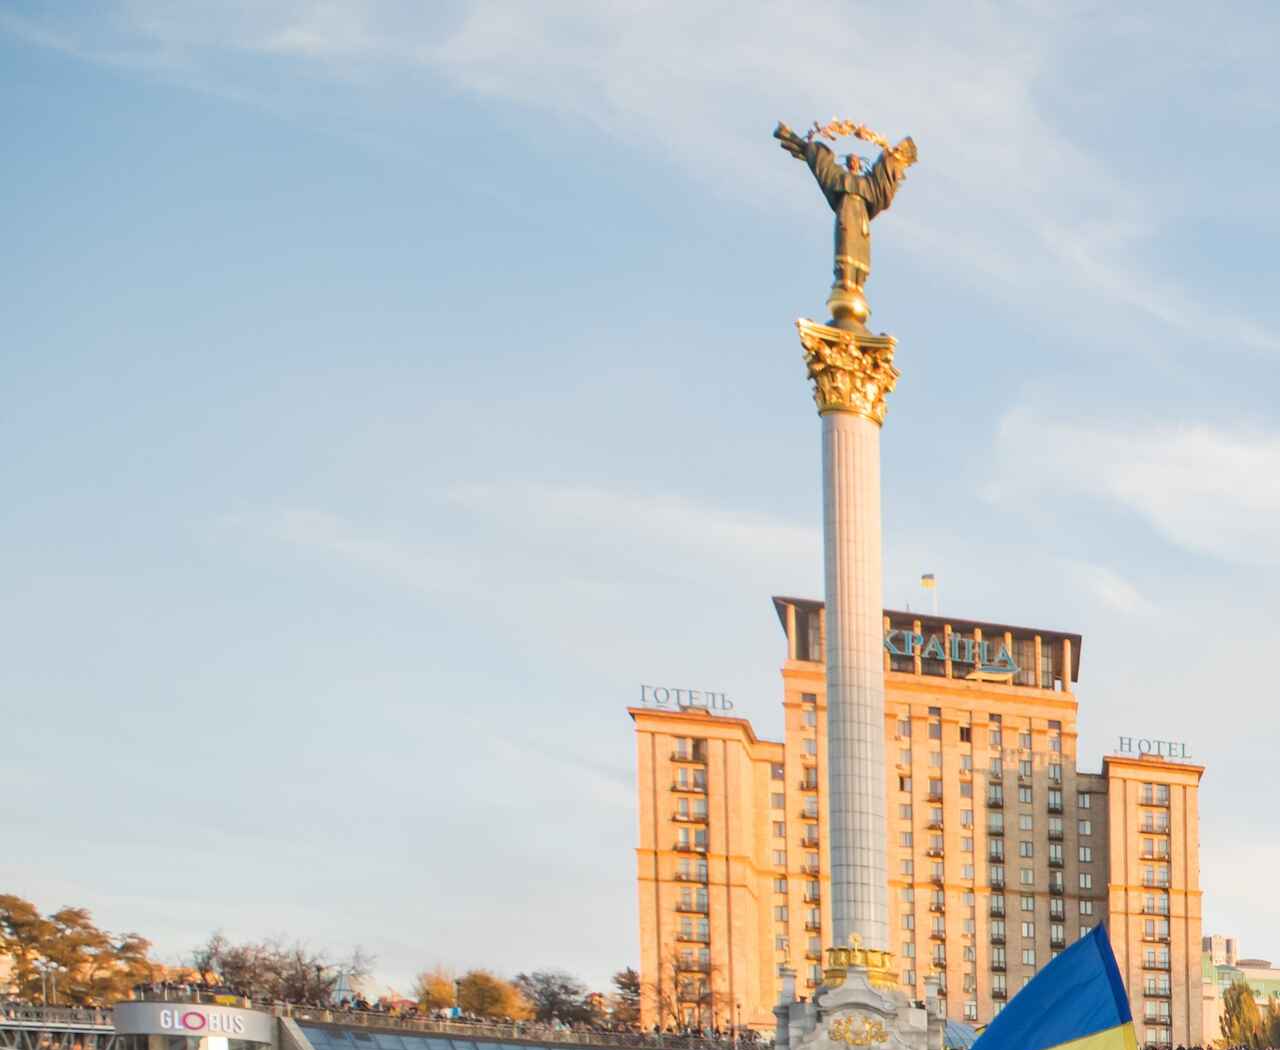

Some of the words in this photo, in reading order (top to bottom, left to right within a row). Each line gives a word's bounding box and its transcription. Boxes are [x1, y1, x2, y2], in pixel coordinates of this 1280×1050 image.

[883, 628, 1021, 671] КРАЇНА
[640, 684, 735, 711] ГОТЕЛЬ
[1119, 736, 1192, 759] HOTEL
[160, 1009, 245, 1033] GLOBUS
